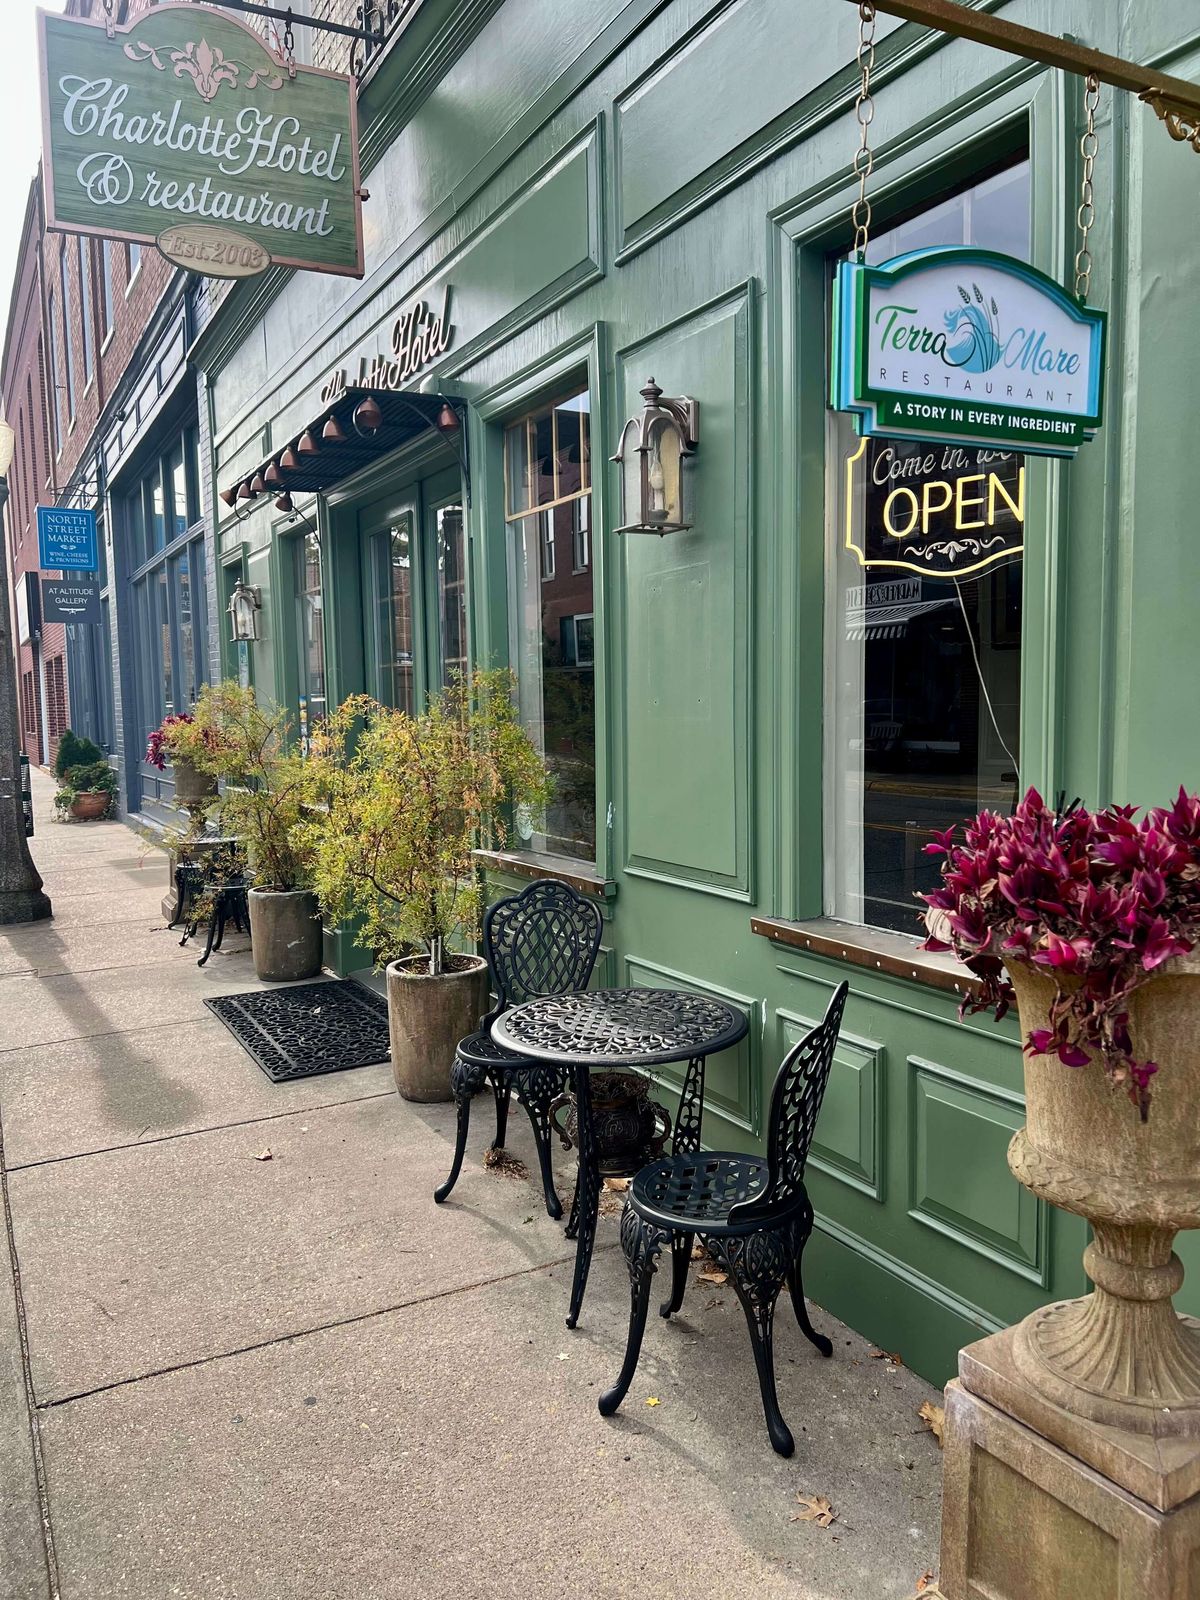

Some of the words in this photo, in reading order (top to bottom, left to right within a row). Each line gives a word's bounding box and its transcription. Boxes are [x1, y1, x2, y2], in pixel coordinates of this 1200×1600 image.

[59, 75, 241, 160] Charlotte
[218, 107, 346, 181] Hotel
[77, 152, 134, 205] &
[140, 171, 335, 237] restaurant
[388, 284, 456, 389] Hotel
[875, 305, 950, 358] Terra
[1003, 327, 1081, 376] Mare
[880, 368, 1073, 404] RESTAURANT
[893, 402, 903, 415] A
[907, 403, 947, 421] STORY
[951, 408, 964, 422] IN
[968, 410, 1005, 427] EVERY
[1008, 416, 1077, 435] INGREDIENT
[872, 447, 937, 485] Come
[47, 514, 87, 526] NORTH
[883, 466, 1024, 538] OPEN
[47, 524, 87, 535] STREET
[47, 534, 88, 544] MARKET
[48, 587, 59, 595] AT
[60, 587, 94, 596] ALTITUDE
[55, 597, 88, 605] GALLERY
